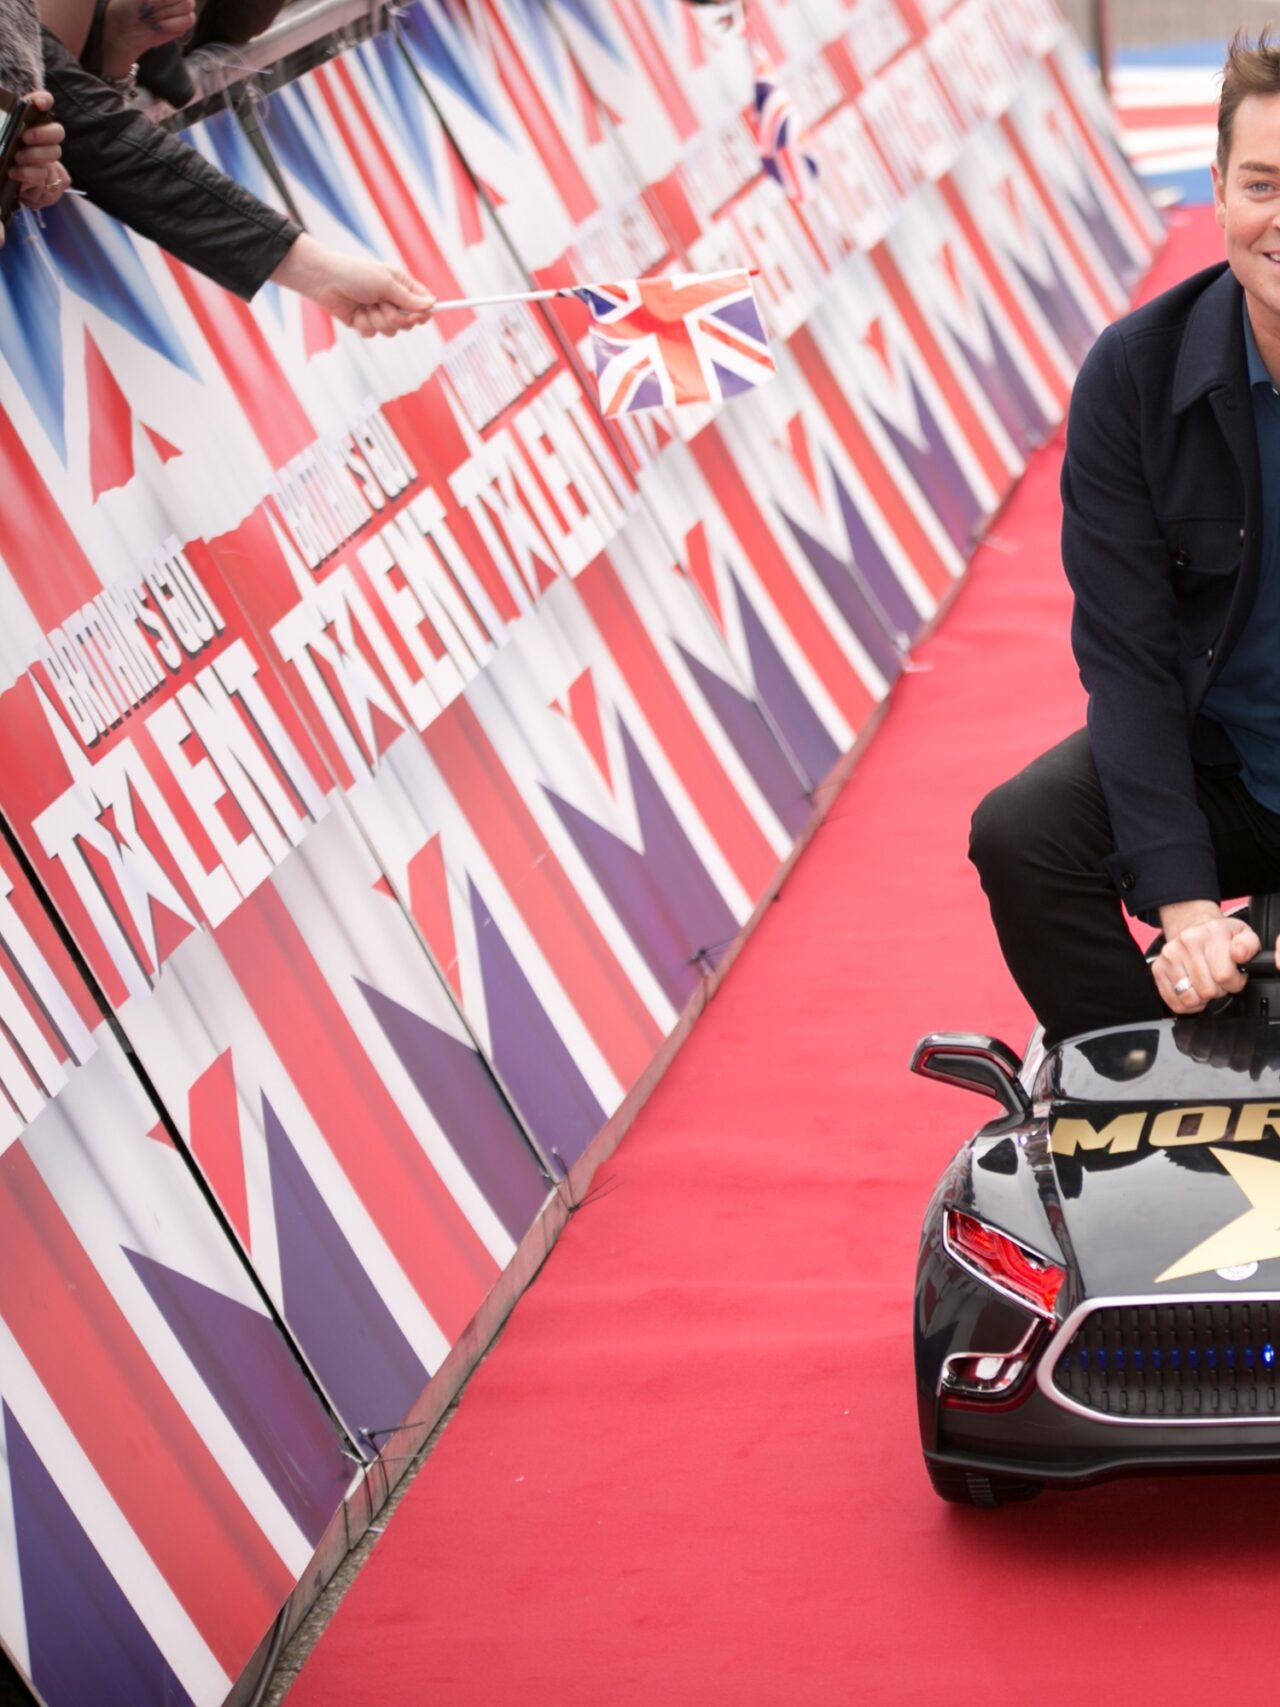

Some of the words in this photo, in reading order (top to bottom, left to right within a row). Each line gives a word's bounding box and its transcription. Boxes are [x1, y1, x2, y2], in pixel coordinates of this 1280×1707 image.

[143, 533, 227, 658] GOT
[447, 370, 638, 614] TALENT
[269, 485, 512, 778] TALENT
[31, 637, 331, 993] TALENT
